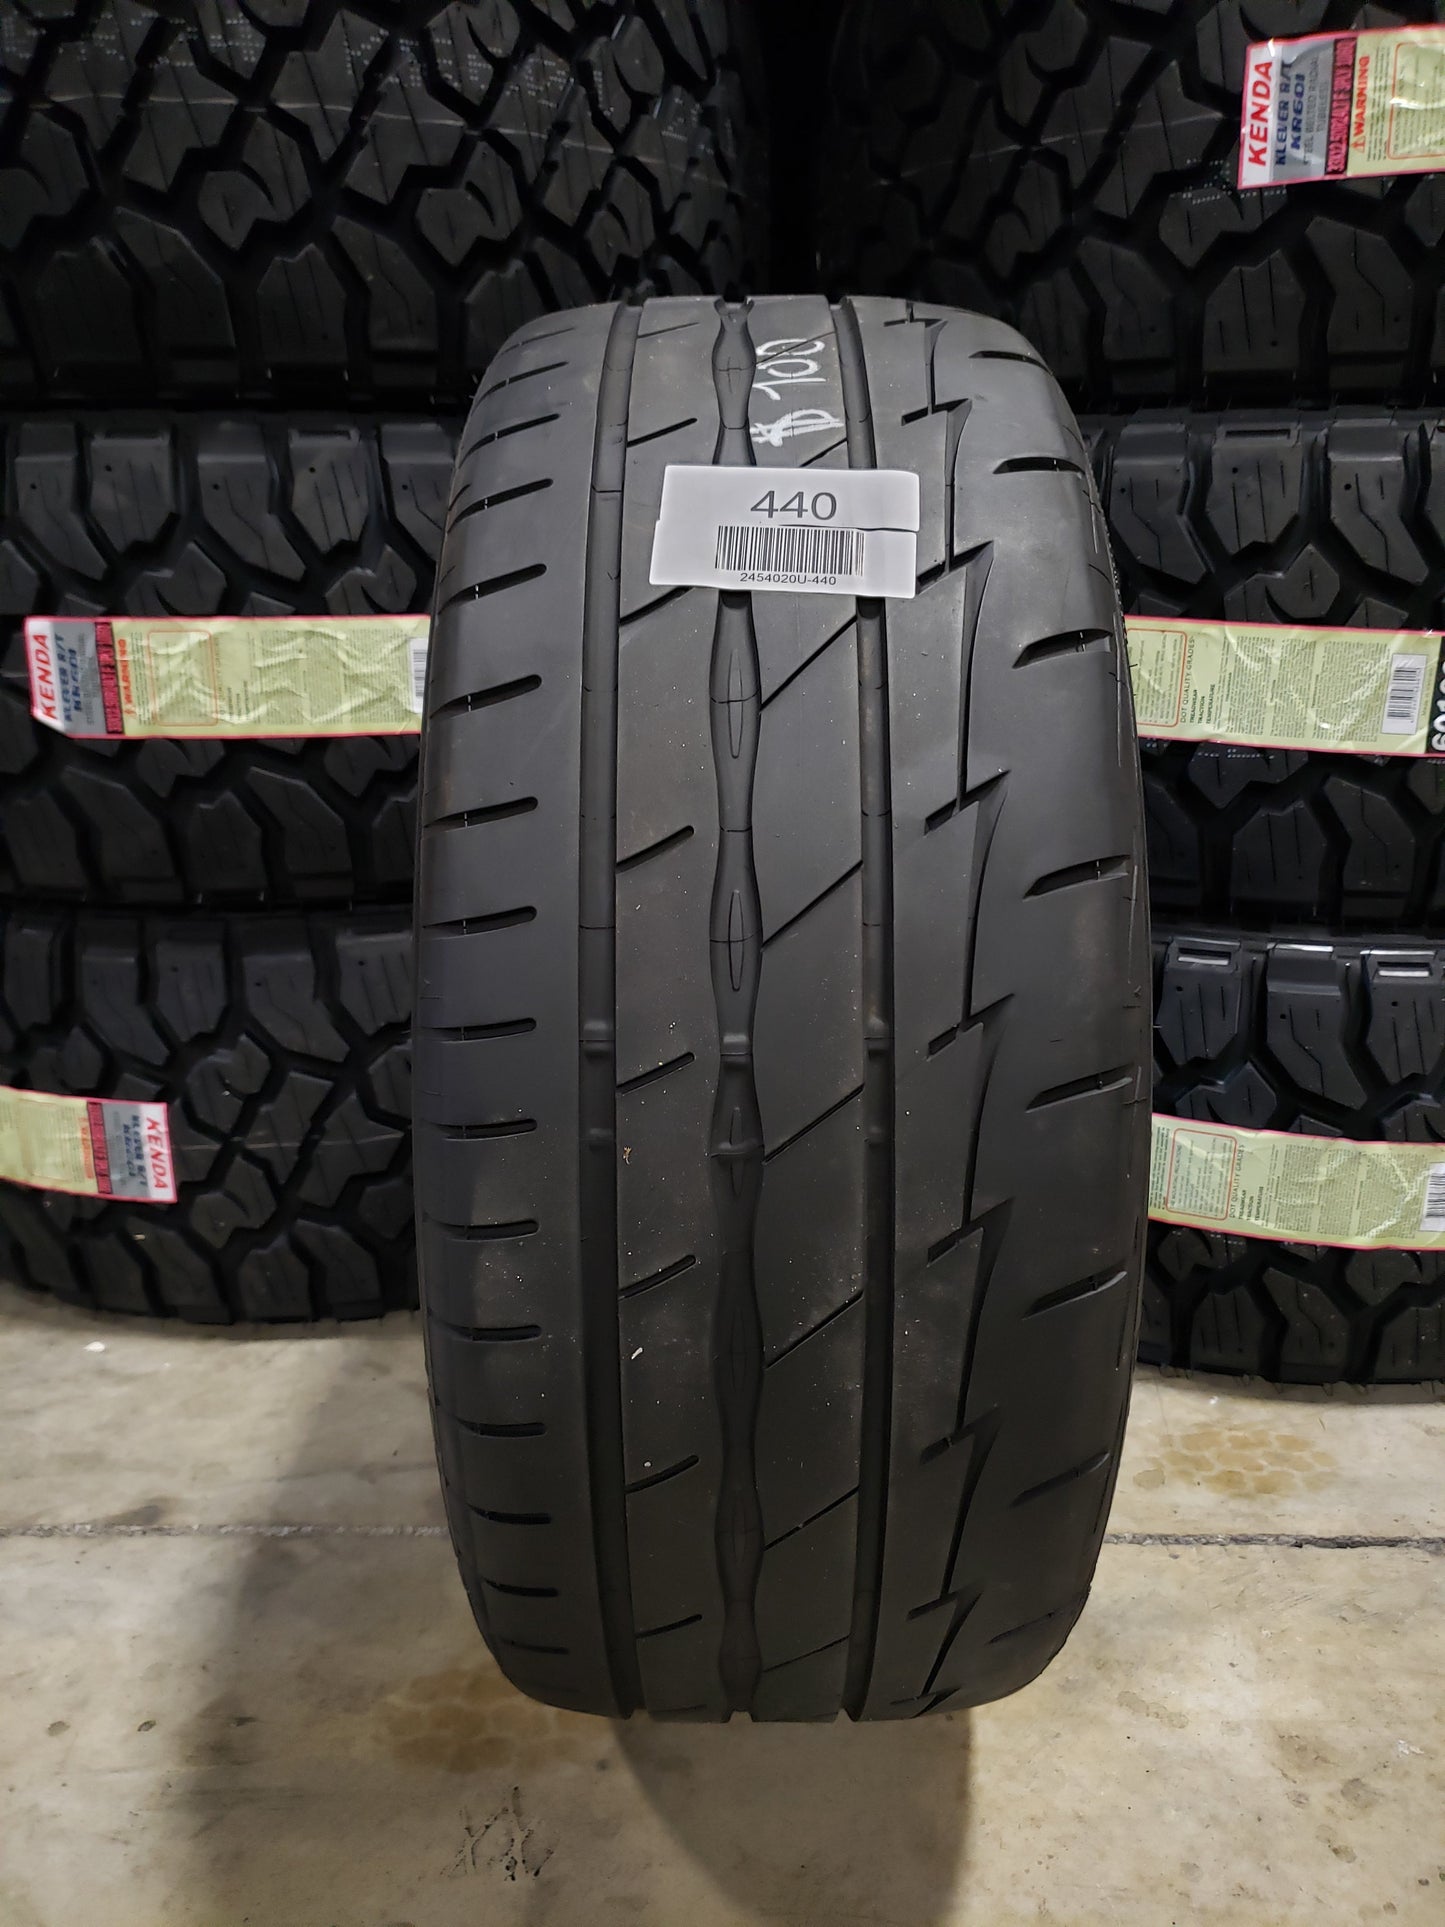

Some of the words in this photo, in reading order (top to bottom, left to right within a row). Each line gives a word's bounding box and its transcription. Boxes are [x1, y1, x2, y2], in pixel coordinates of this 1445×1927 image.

[1248, 62, 1272, 166] KENDA
[1290, 73, 1305, 150] KR601
[1353, 56, 1369, 136] WARNING
[1275, 101, 1289, 165] KLEVER
[750, 490, 837, 520] 440
[740, 572, 836, 585] 2454020U-440
[32, 634, 57, 720] KENDA
[1190, 689, 1198, 723] TREADWEAR
[1206, 684, 1215, 724] TEMPERATURE
[146, 1117, 168, 1188] KENDA
[1231, 1174, 1240, 1202] QUALITY
